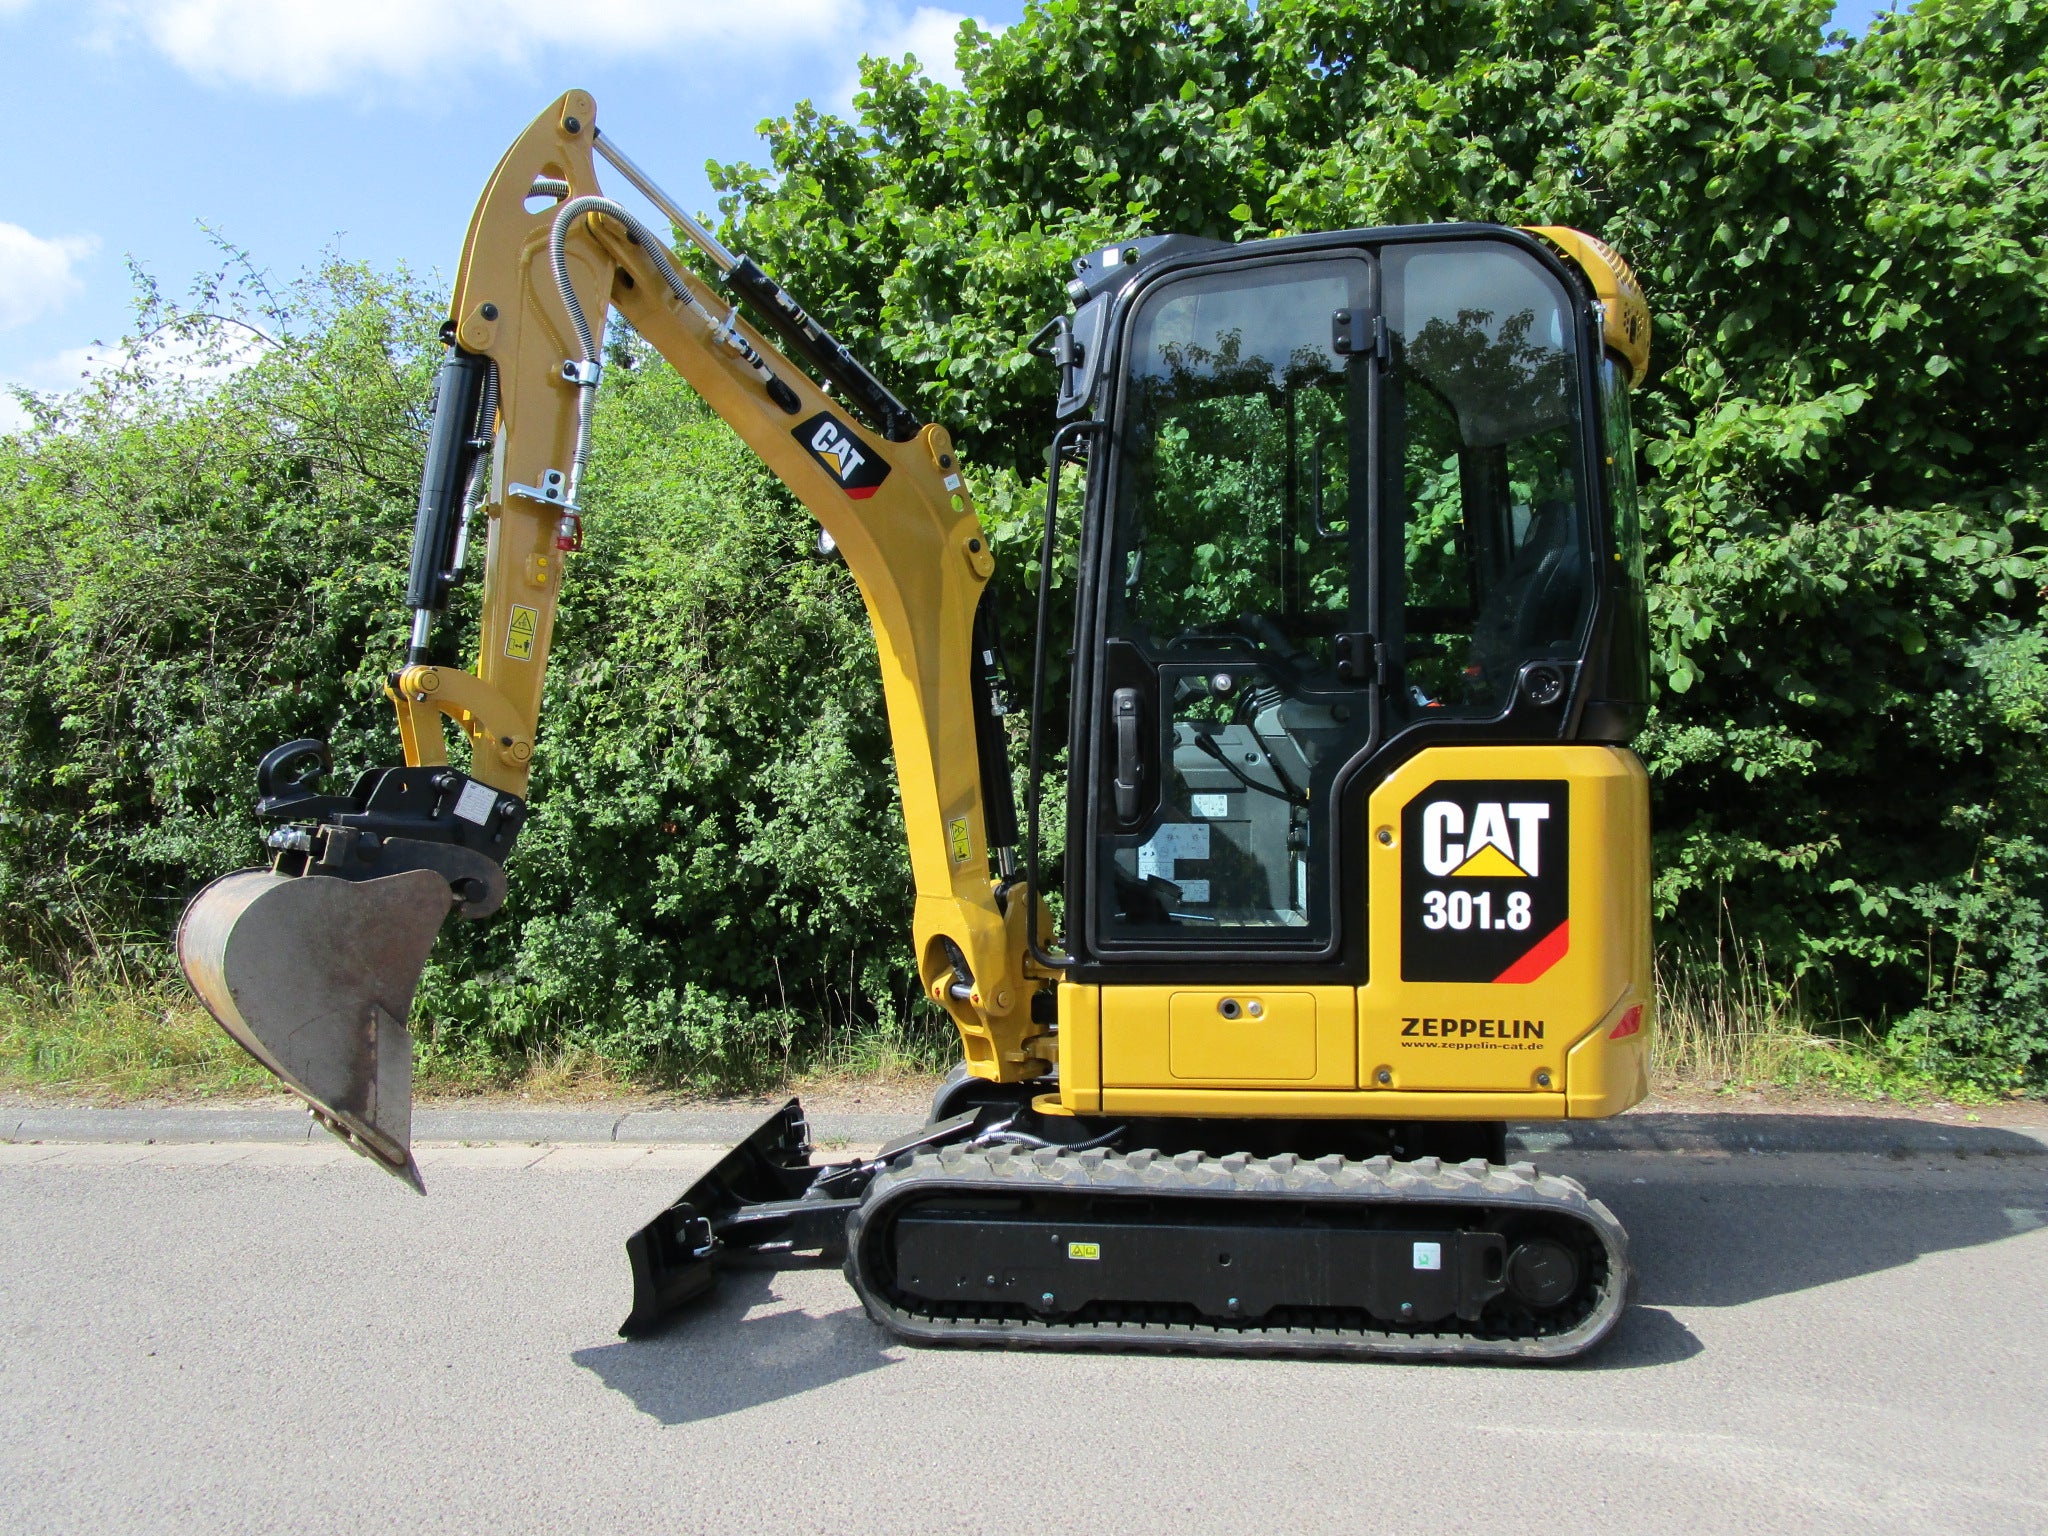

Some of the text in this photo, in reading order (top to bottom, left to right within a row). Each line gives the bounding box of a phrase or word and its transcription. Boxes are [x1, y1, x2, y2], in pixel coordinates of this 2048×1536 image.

[811, 421, 866, 481] CAT
[1423, 801, 1550, 877] CAT
[1423, 890, 1531, 930] 301.8
[1401, 1017, 1544, 1039] ZEPPELIN
[1401, 1041, 1544, 1051] www.zeppelin-cat.de
